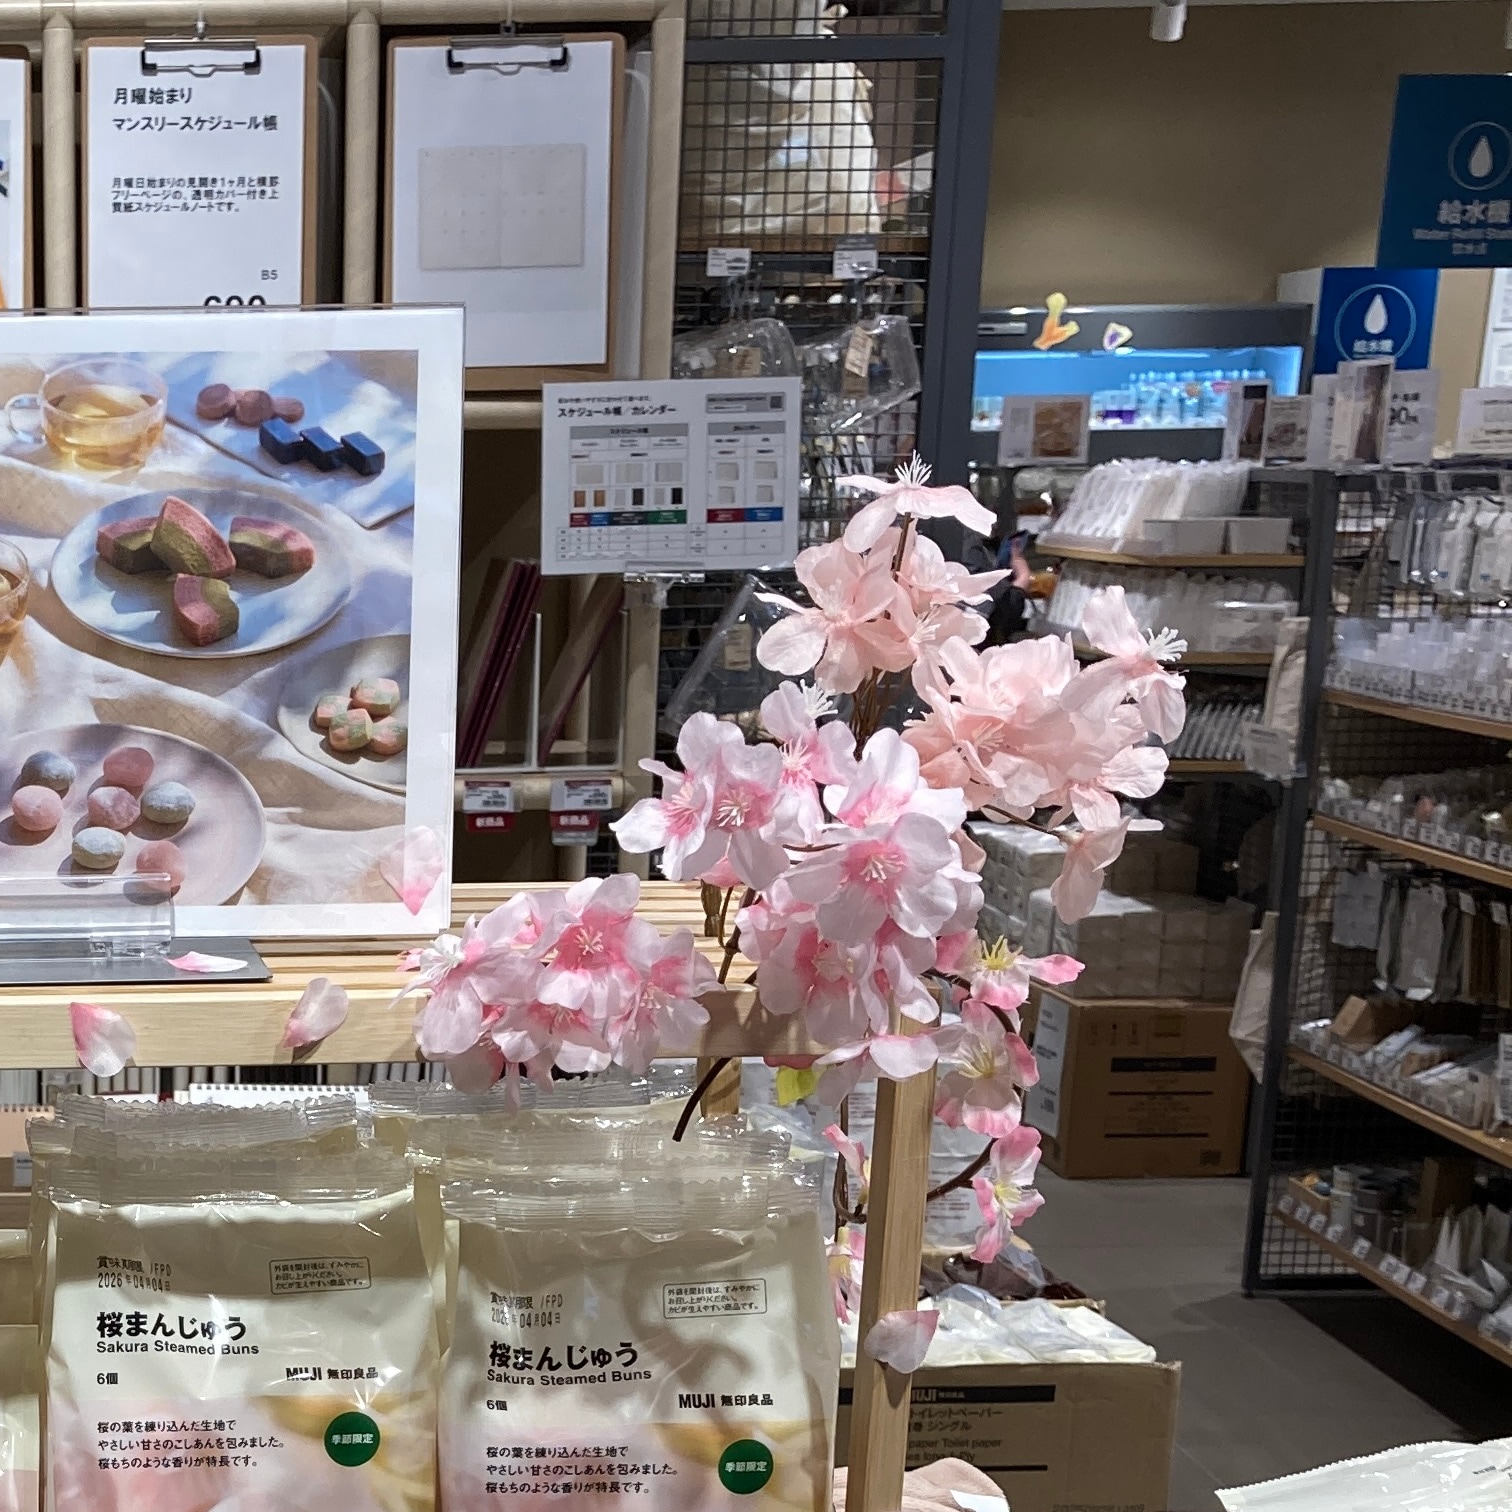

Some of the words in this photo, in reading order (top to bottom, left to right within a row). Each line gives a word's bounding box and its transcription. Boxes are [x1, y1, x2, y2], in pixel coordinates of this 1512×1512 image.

[113, 88, 193, 105] 月曜始まり
[112, 115, 278, 132] マンスリースケジュール帳
[261, 269, 278, 280] B5
[96, 1311, 247, 1341] 桜まんじゅう
[96, 1341, 149, 1354] Sakura
[154, 1341, 216, 1355] Steamed
[220, 1343, 260, 1355] Buns
[489, 1340, 638, 1372] 桜まんじゅう
[97, 1372, 118, 1386] 6個
[286, 1367, 322, 1381] MUJI
[327, 1367, 379, 1380] 無印良品
[487, 1369, 535, 1386] Sakura
[540, 1371, 607, 1386] Steamed
[611, 1368, 652, 1382] Buns
[486, 1399, 508, 1412] 6個
[97, 1419, 236, 1433] 桜の葉を練り込んだ生地で
[98, 1436, 285, 1451] やさしい甘さのこしあんを包みました。
[98, 1455, 257, 1470] 桜もちのような香りが特長です。
